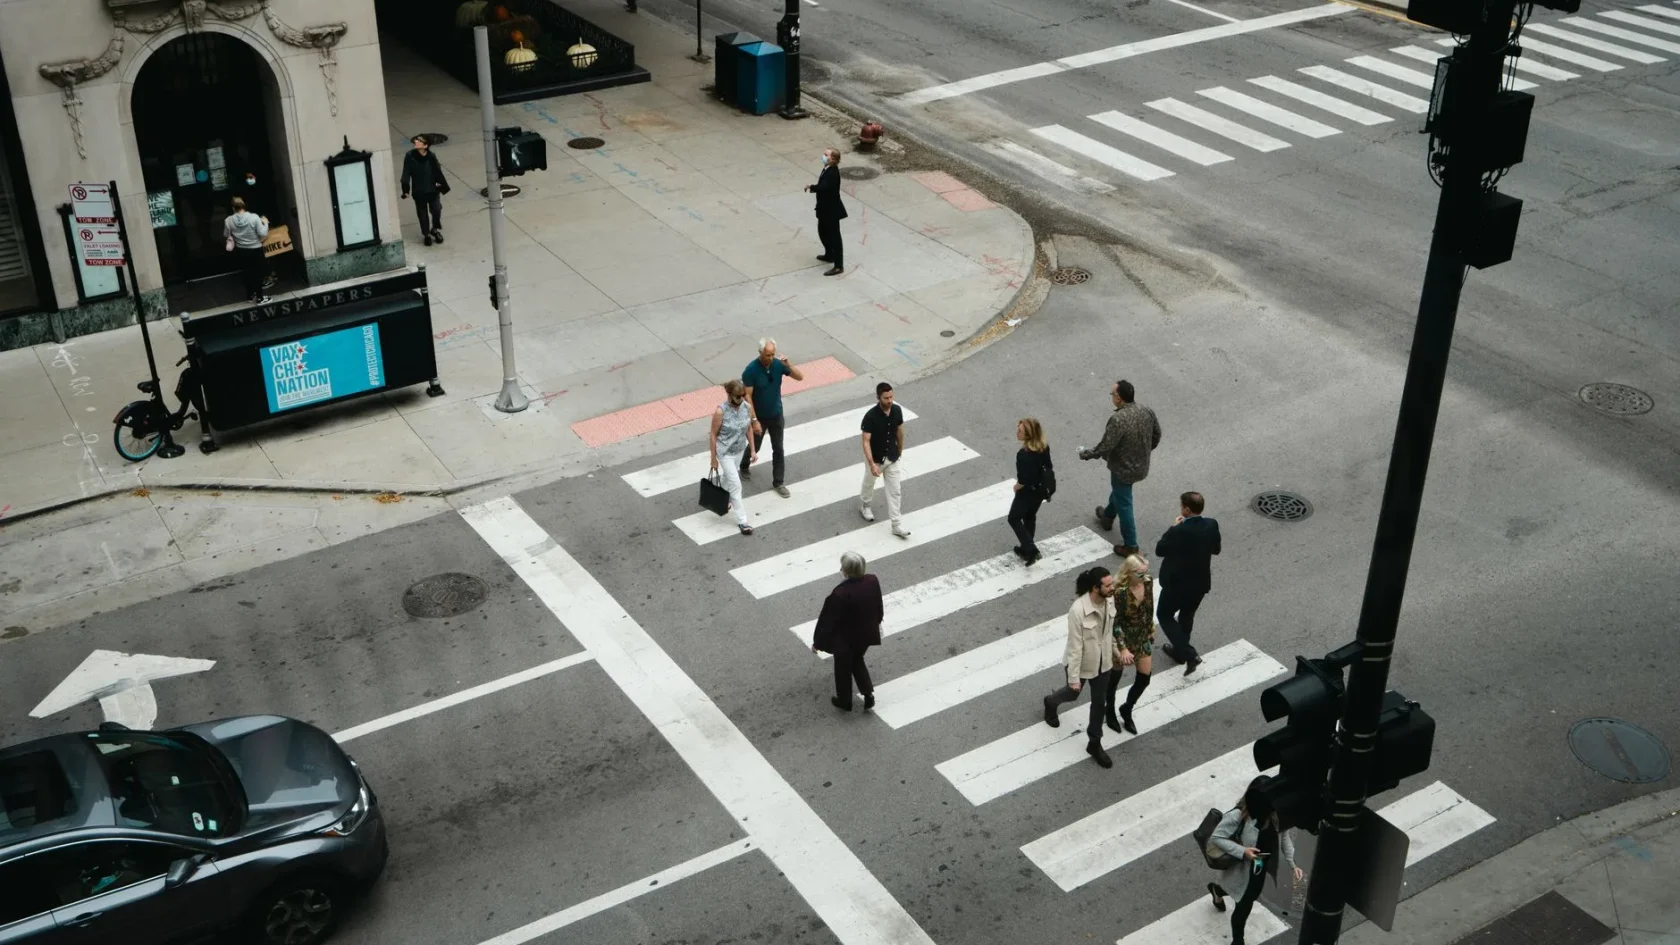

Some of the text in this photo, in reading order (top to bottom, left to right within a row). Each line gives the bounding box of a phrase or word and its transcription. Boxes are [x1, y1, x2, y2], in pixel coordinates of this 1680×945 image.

[263, 241, 281, 253] NIKE
[233, 286, 373, 325] NEWSPAPERS
[272, 344, 299, 363] VAX
[362, 325, 380, 386] #PROTECTCHICAGO
[276, 370, 329, 395] NATION
